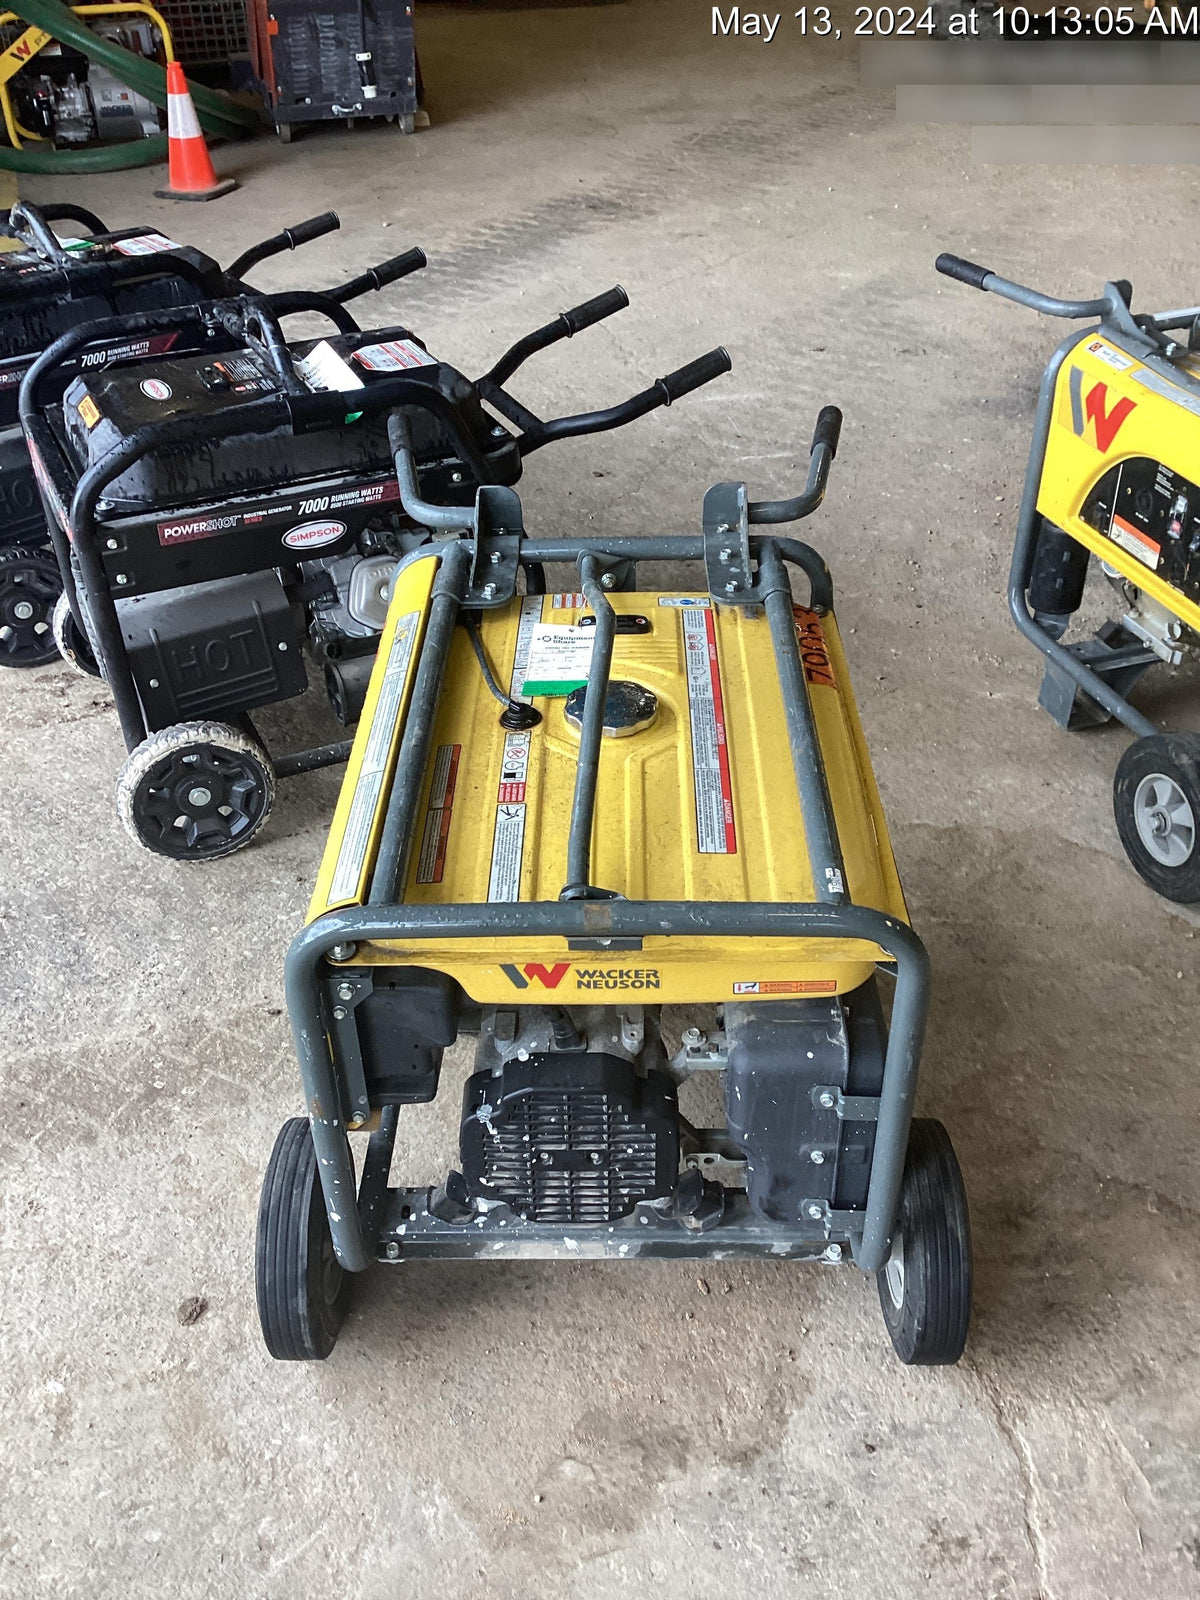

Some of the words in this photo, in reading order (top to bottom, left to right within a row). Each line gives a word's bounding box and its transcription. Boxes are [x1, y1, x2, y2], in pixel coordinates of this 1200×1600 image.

[107, 345, 131, 356] RUNNING
[131, 341, 150, 351] WATTS
[81, 351, 106, 367] 7000
[330, 490, 360, 502] RUNNING
[360, 486, 384, 497] WATTS
[342, 497, 365, 507] STARTING
[364, 493, 382, 502] WATTS
[243, 509, 268, 519] INDUSTRIAL
[268, 505, 292, 515] GENERATOR
[298, 497, 330, 515] 7000
[289, 525, 341, 544] SIMPSON
[171, 629, 254, 684] HOT
[725, 802, 733, 824] DANGER
[575, 968, 660, 979] WACKER
[577, 979, 661, 989] NEUSON
